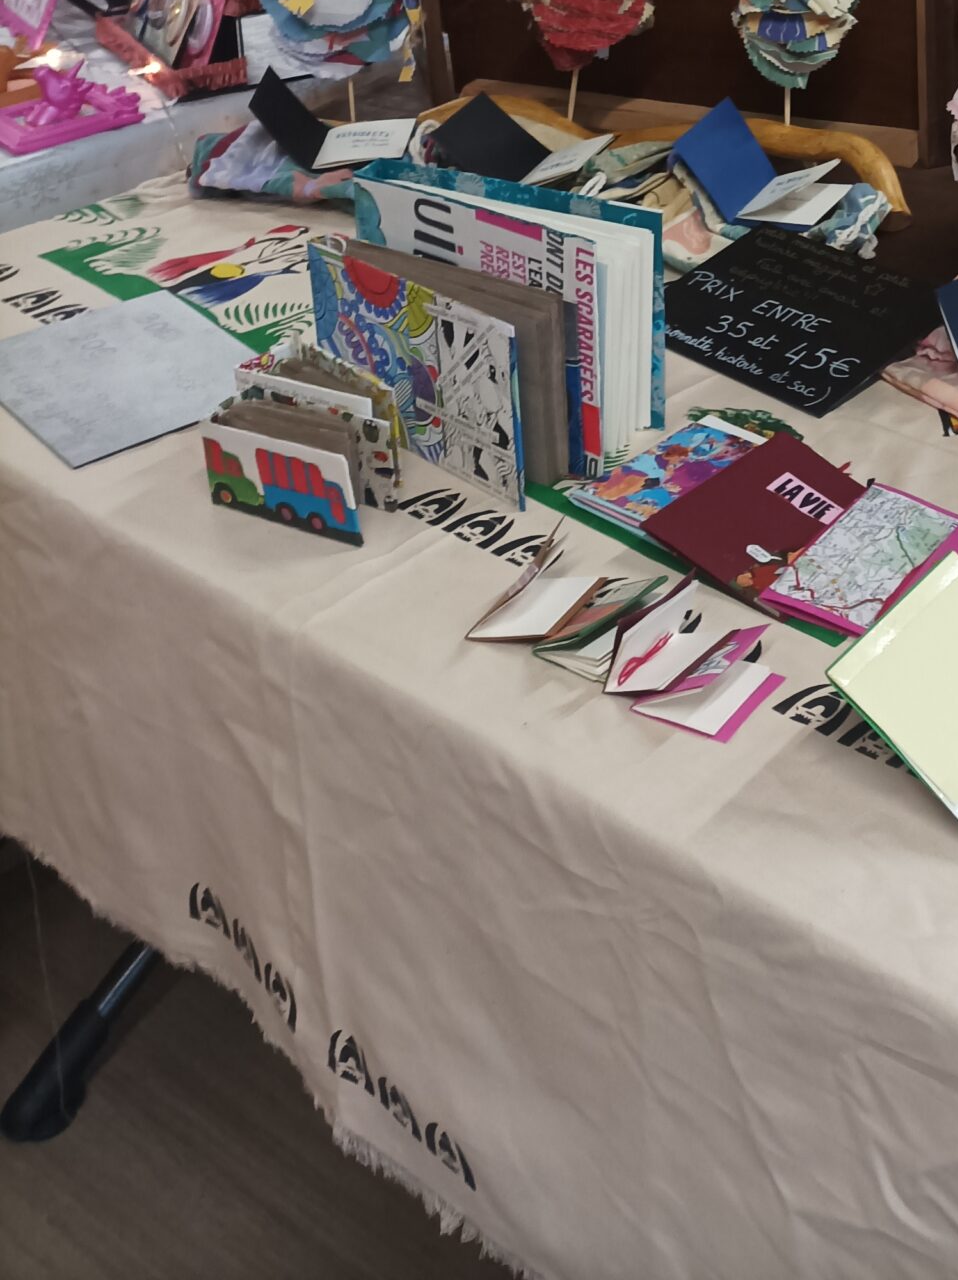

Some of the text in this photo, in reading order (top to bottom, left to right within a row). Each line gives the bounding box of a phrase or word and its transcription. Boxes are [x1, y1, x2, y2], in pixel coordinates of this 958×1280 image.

[575, 247, 595, 286] LES
[687, 270, 744, 303] PRIX
[752, 299, 832, 333] ENTRE
[706, 314, 861, 378] 35 et 45€
[768, 370, 787, 385] et
[774, 477, 836, 521] LA VIE
